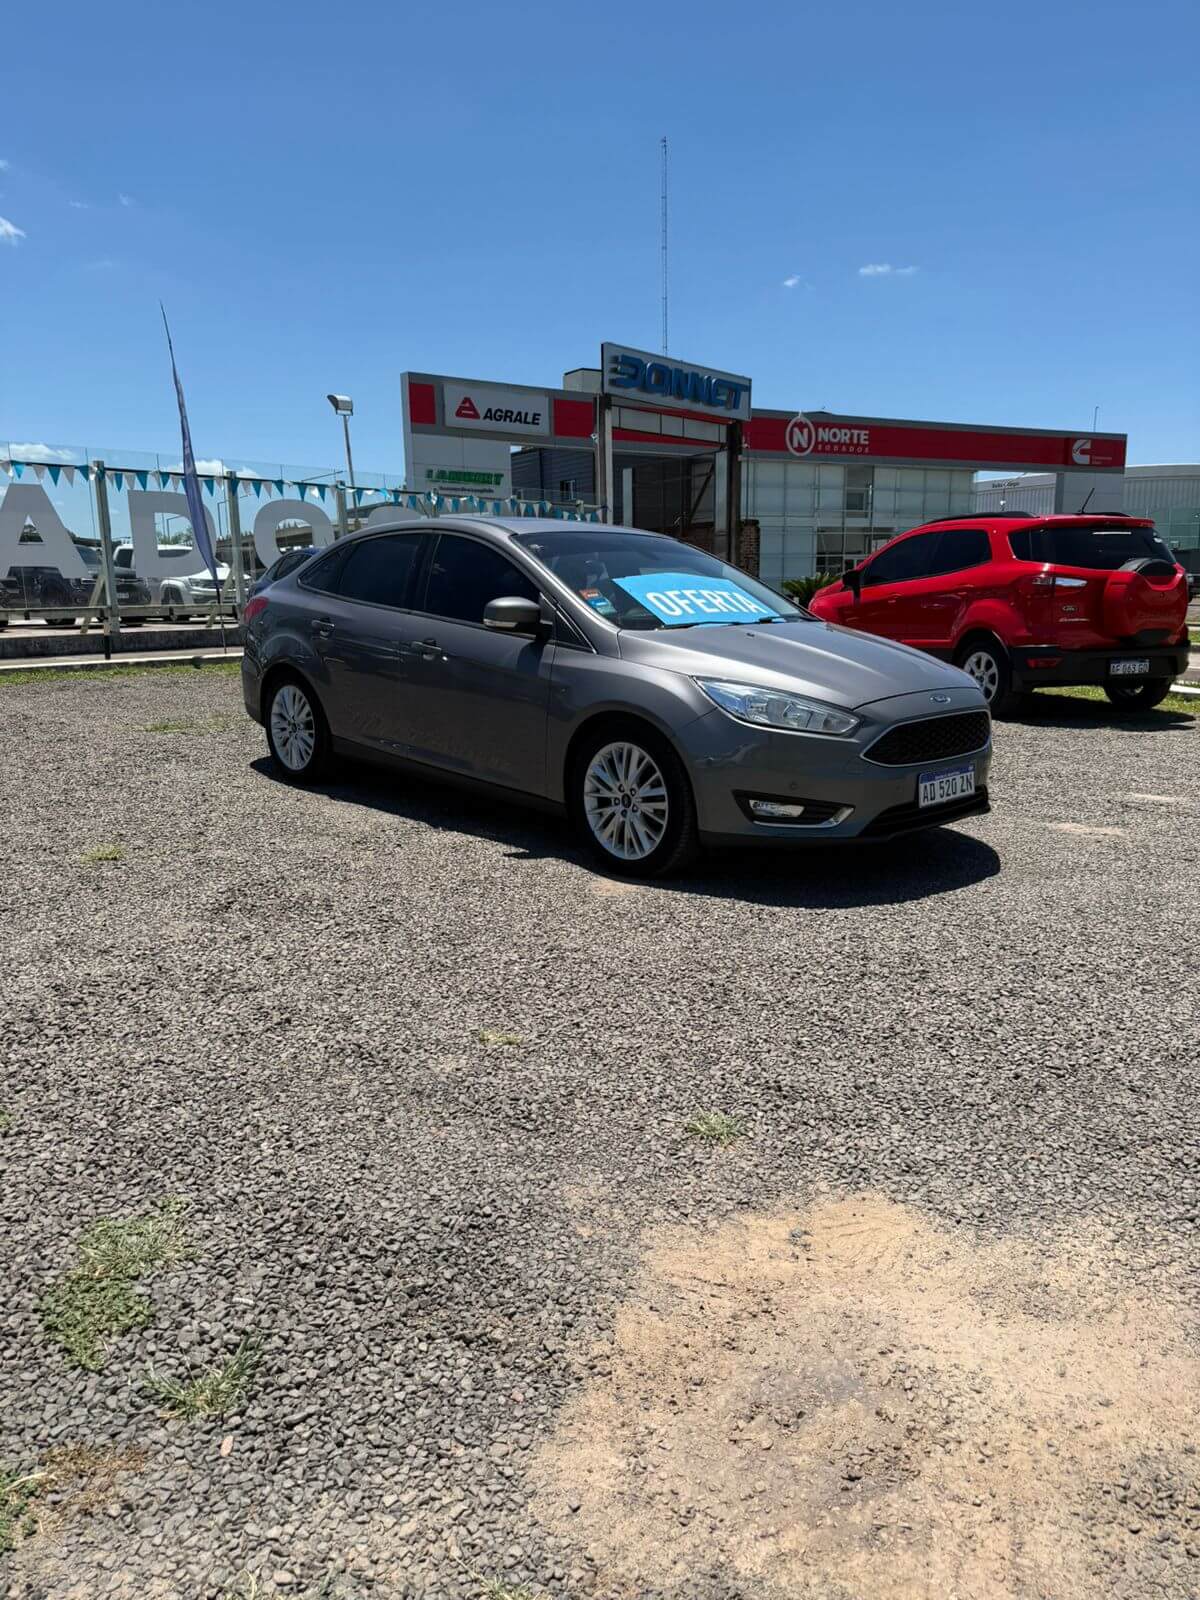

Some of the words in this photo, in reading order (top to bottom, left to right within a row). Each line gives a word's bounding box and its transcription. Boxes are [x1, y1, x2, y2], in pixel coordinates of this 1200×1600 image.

[483, 408, 541, 425] AGRALE
[817, 427, 869, 445] NORTE
[646, 589, 768, 617] OFERTA
[922, 783, 936, 803] AD
[939, 777, 958, 799] 520
[960, 773, 973, 793] ZN
